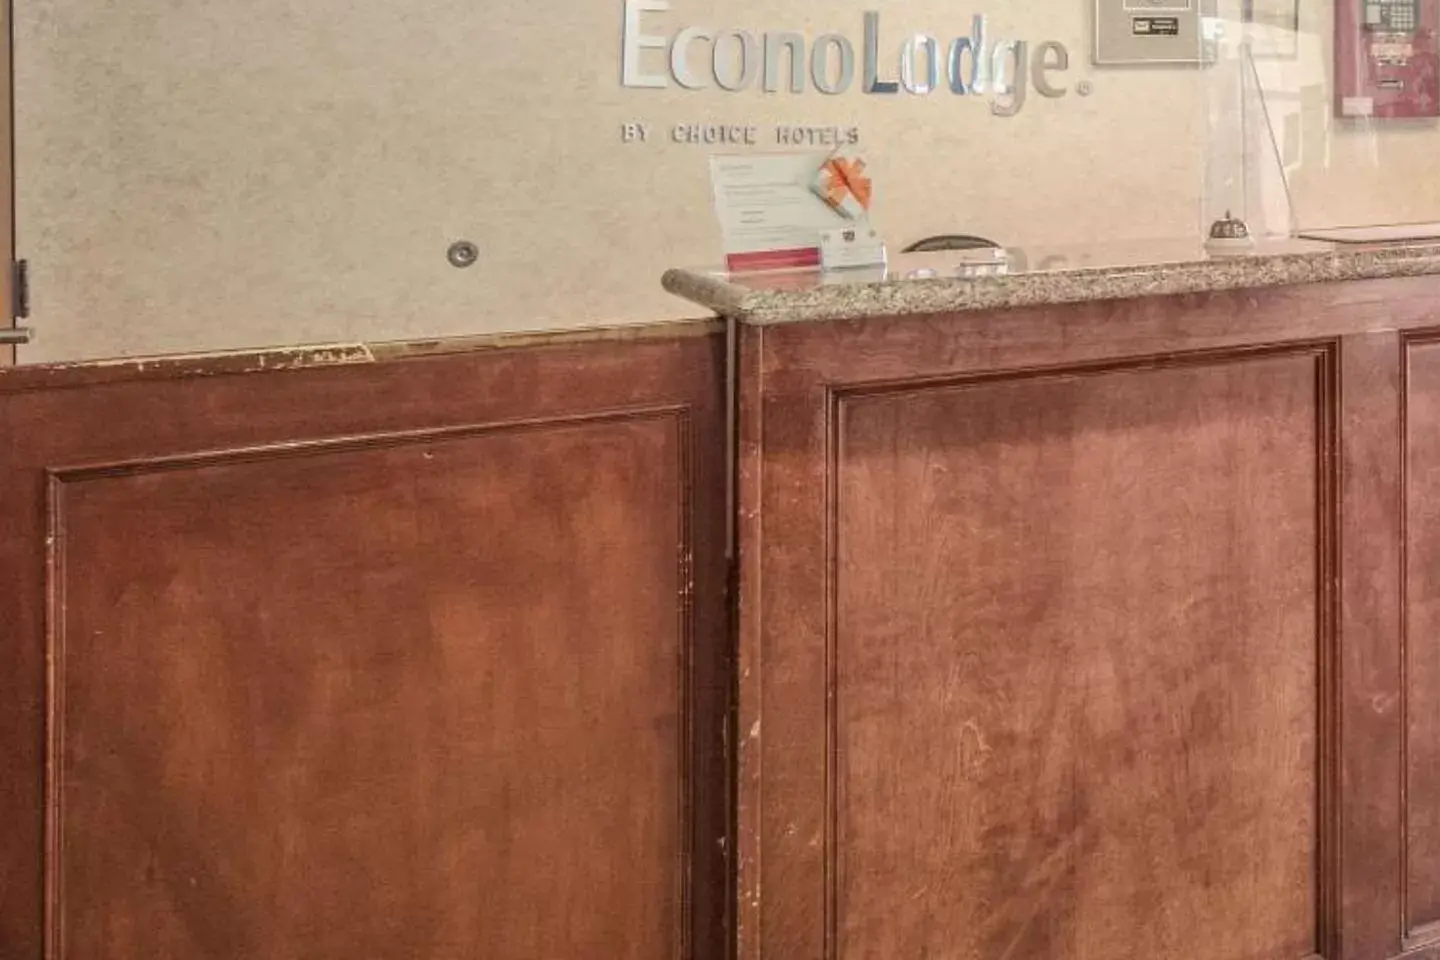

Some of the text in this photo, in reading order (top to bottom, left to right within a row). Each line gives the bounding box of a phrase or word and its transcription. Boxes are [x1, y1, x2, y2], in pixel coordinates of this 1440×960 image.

[621, 123, 860, 146] BY CHOICE HOTELS
